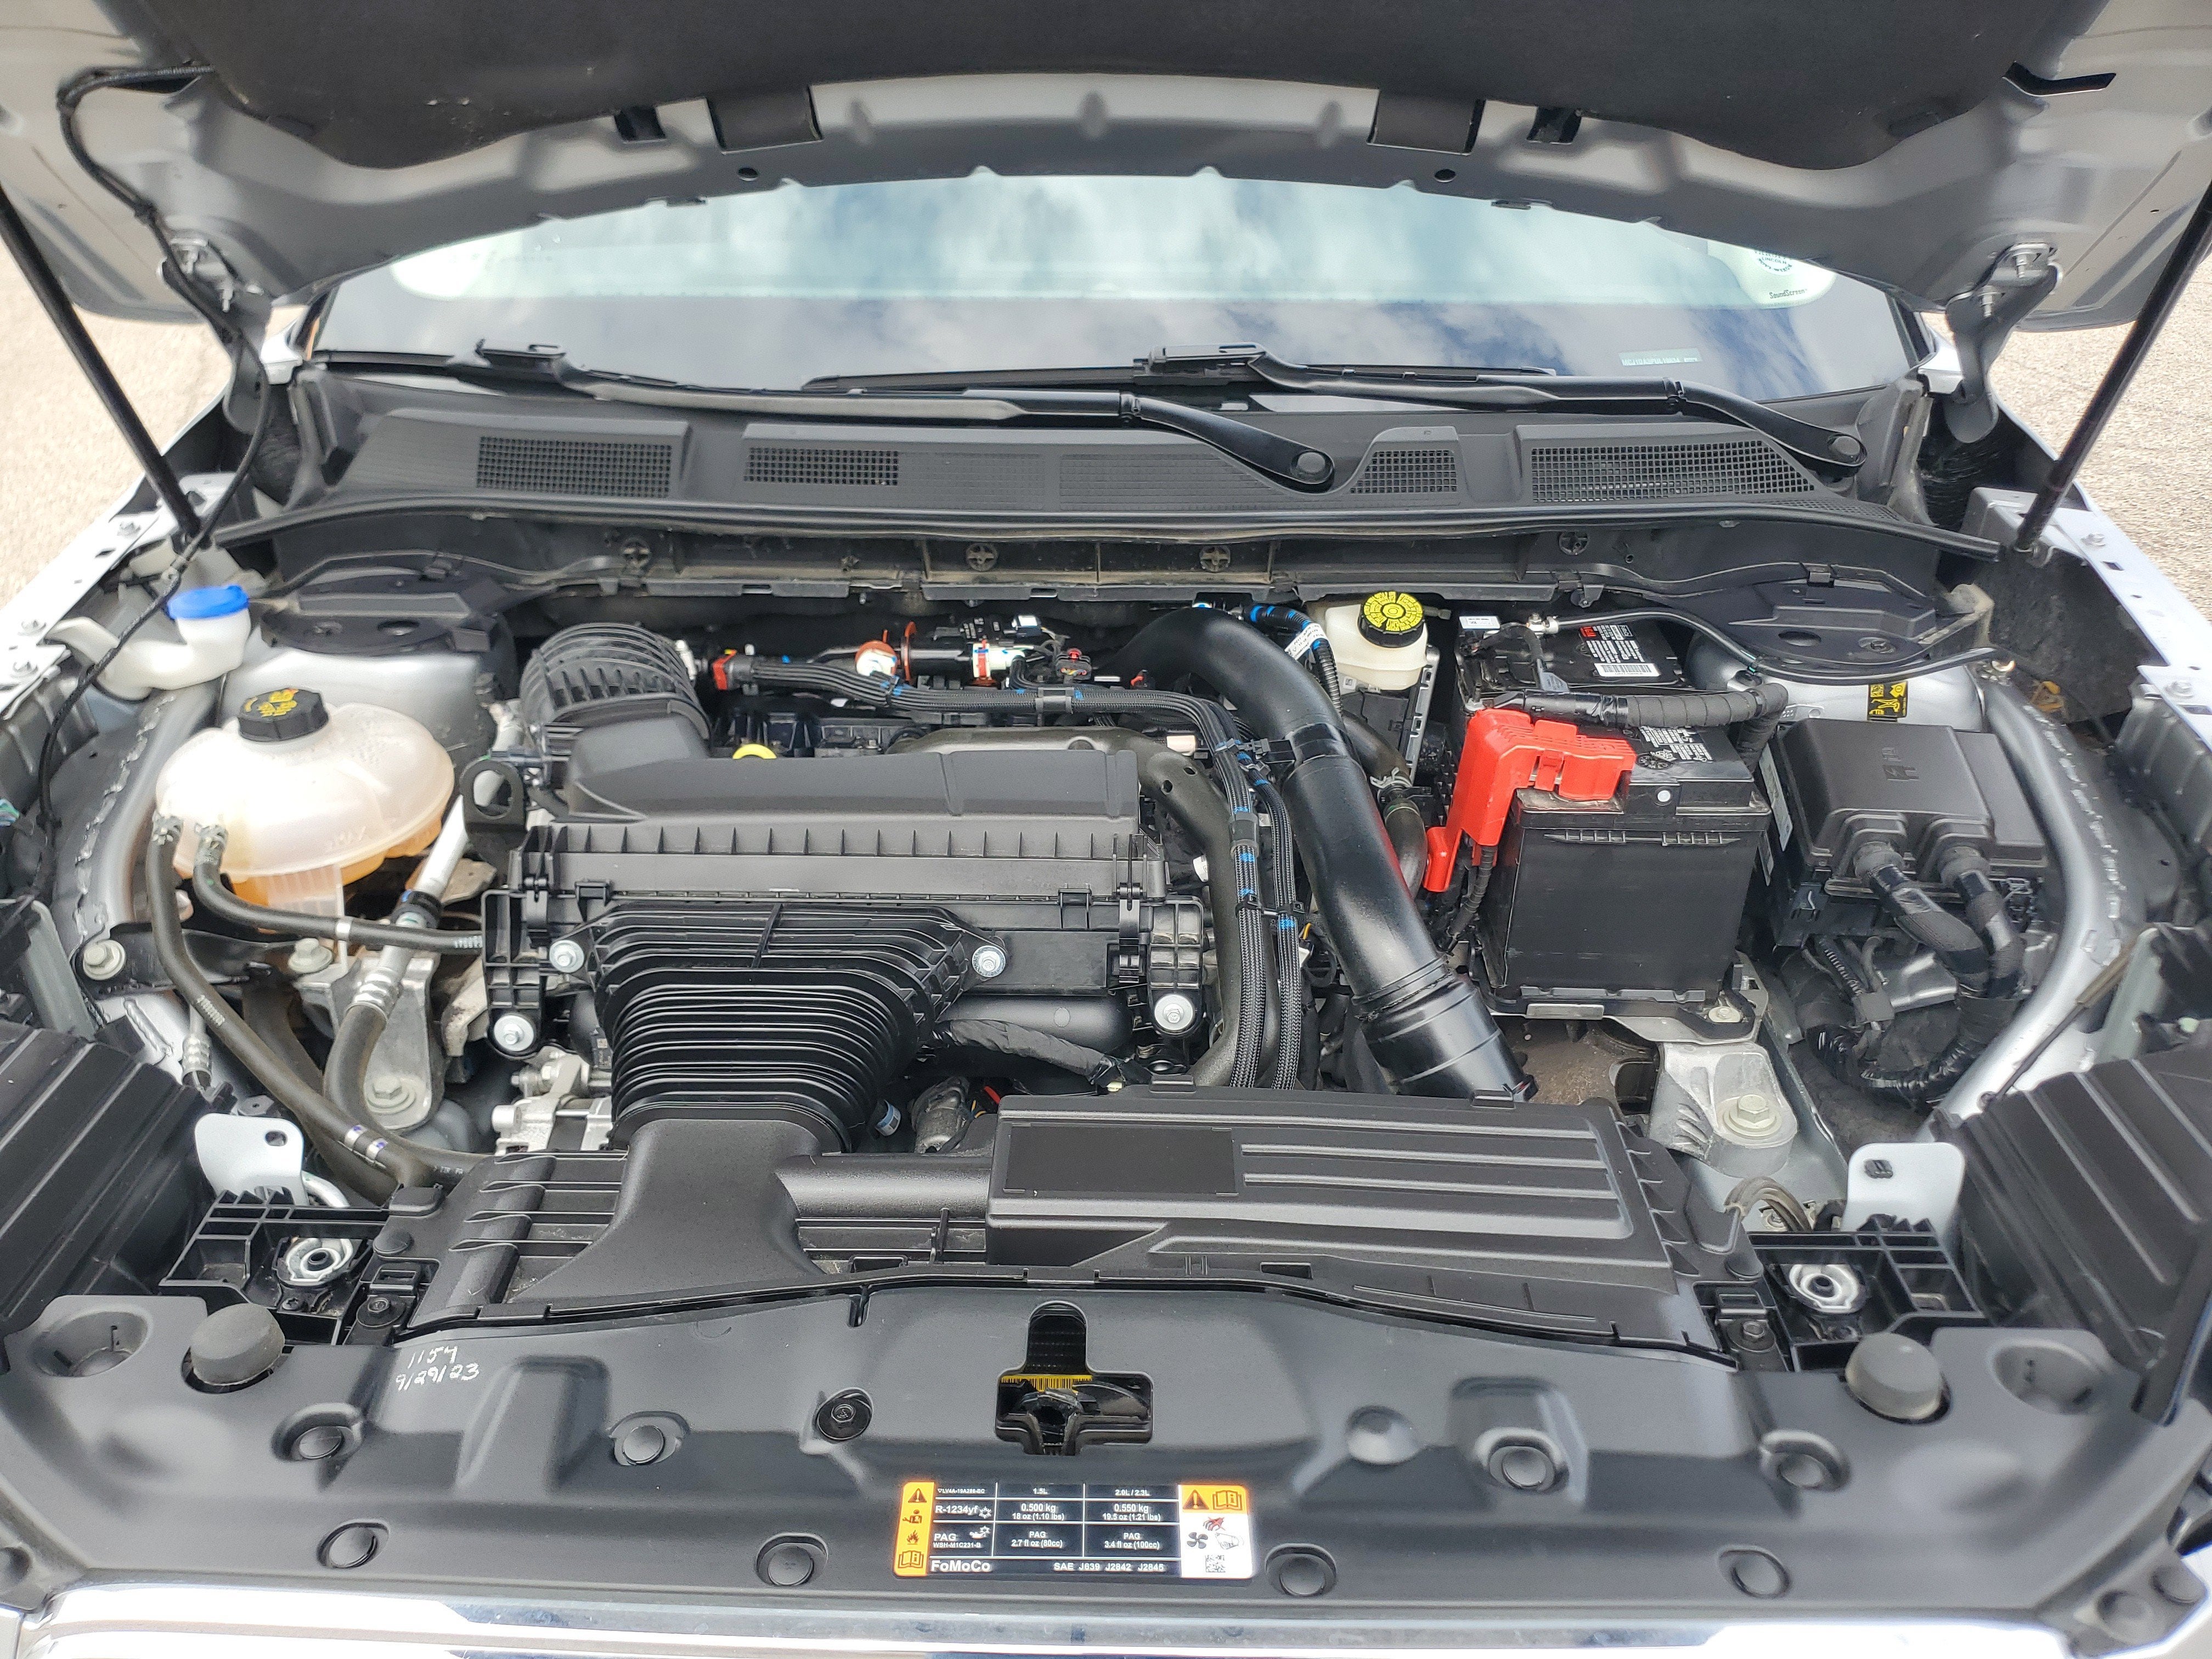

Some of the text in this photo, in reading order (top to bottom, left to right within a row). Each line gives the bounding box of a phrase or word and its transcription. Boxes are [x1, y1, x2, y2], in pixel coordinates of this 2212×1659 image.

[935, 1504, 979, 1515] R-1234yf
[1021, 1503, 1057, 1513] 0.500 kg
[1114, 1504, 1149, 1514] 0.550 kg
[1052, 1513, 1064, 1521] lbs)
[934, 1533, 957, 1541] PAG
[1041, 1539, 1063, 1548] (80cc)
[1134, 1541, 1160, 1550] (100cc)
[930, 1560, 991, 1572] FoMoCo
[1053, 1562, 1074, 1571] SAE
[1079, 1562, 1101, 1571] J639
[1137, 1564, 1164, 1572] J2845
